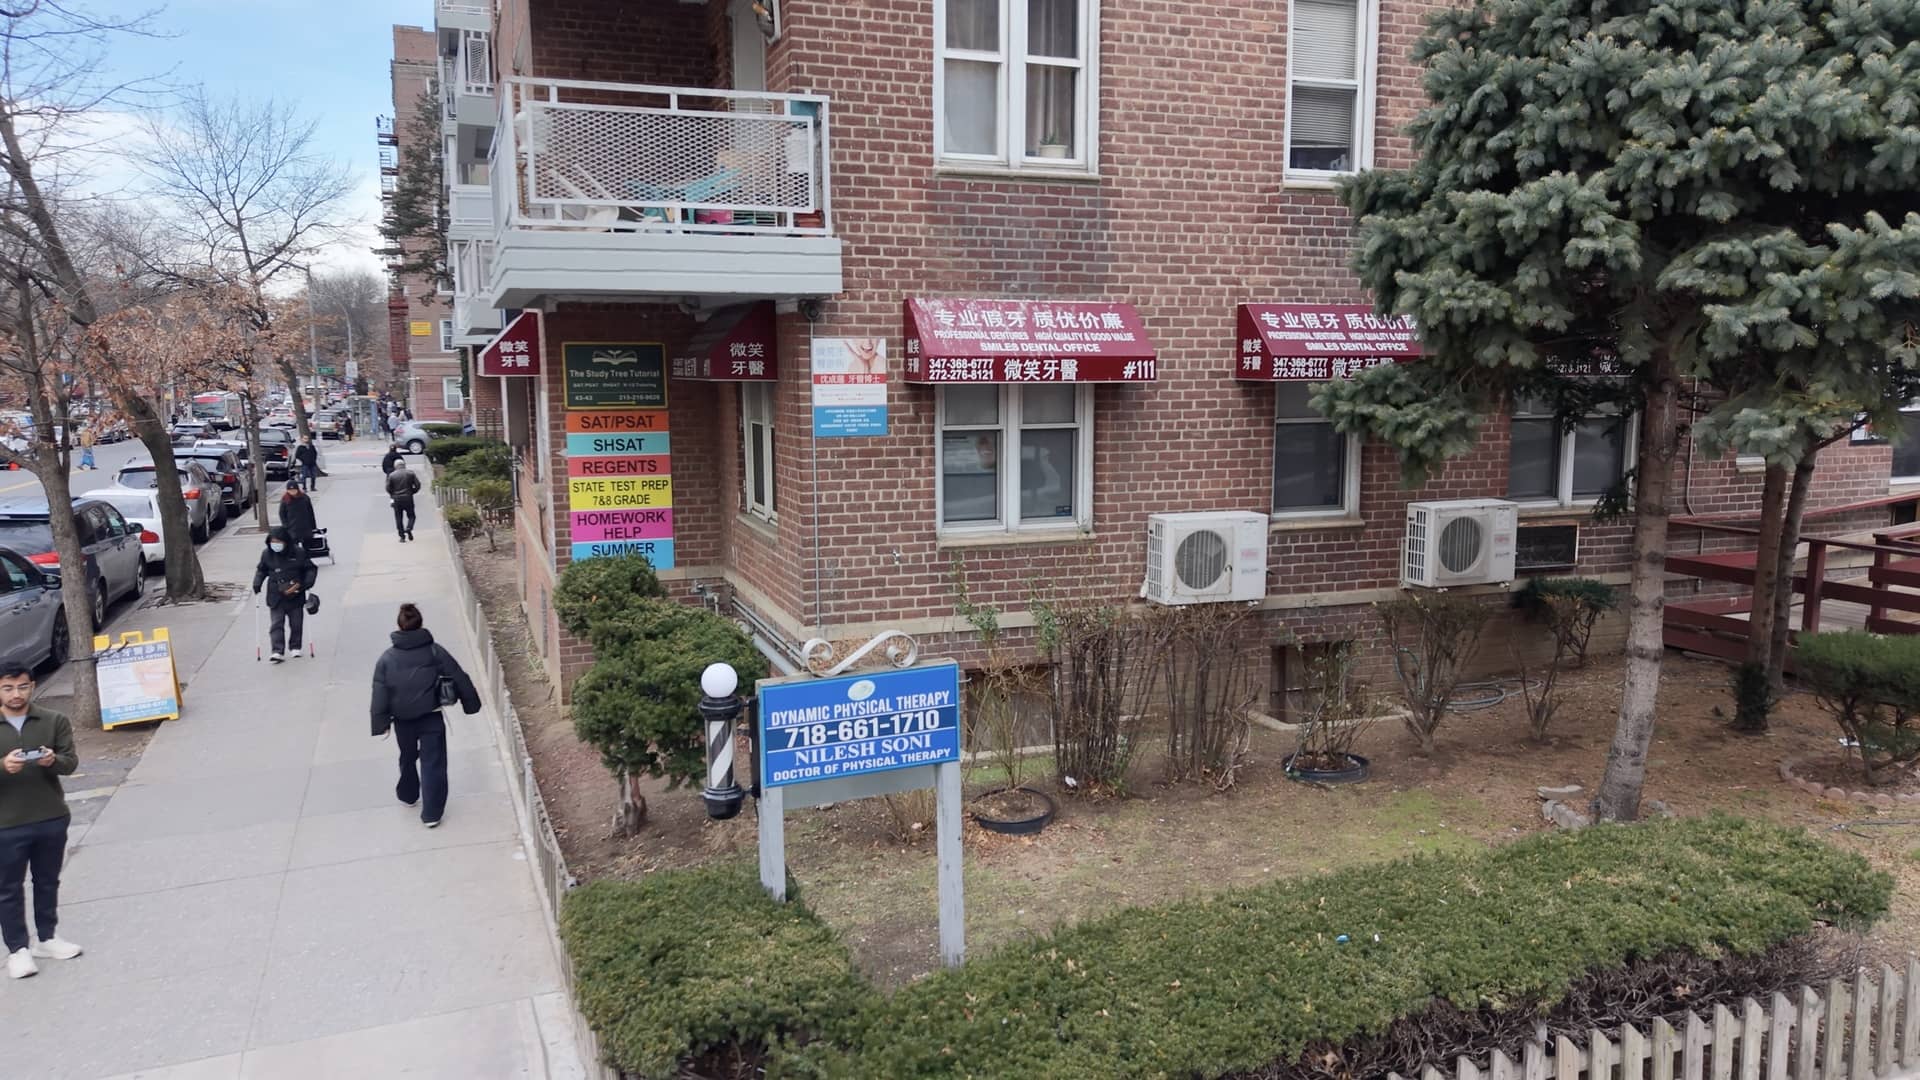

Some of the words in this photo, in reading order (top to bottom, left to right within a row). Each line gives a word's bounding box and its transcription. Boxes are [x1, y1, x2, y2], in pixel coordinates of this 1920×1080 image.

[934, 308, 1027, 328] 专业假牙
[1034, 310, 1125, 330] 质优价廉
[1260, 312, 1340, 329] 专业假牙
[934, 330, 990, 339] PROFESSIONAL
[730, 342, 764, 357] 微笑
[980, 342, 1019, 352] SMILES
[1020, 342, 1062, 352] DENTAL
[1062, 343, 1101, 352] OFFICE
[1305, 342, 1340, 351] SMILES
[1340, 342, 1376, 351] DENTAL
[1376, 342, 1408, 351] OFFICE
[731, 360, 765, 376] 牙醫
[928, 358, 994, 369] 347-368-6777
[1004, 358, 1078, 381] 微笑牙醫
[1122, 360, 1155, 380] #111
[569, 370, 584, 378] The
[586, 370, 609, 380] Study
[610, 370, 629, 378] Tree
[630, 370, 660, 378] Tutorial
[928, 369, 994, 380] 272-276-8121
[580, 416, 655, 429] SAT/PSAT
[594, 438, 645, 452] SHSAT
[582, 460, 657, 474] REGENTS
[572, 481, 604, 493] STATE
[611, 480, 636, 492] TEST
[642, 480, 669, 490] PREP
[592, 496, 612, 506] 7&8
[614, 494, 650, 505] GRADE
[577, 512, 666, 526] HOMEWORK
[604, 527, 642, 540] HELP
[592, 542, 655, 557] SUMMER
[771, 706, 830, 726] DYNAMIC
[834, 698, 893, 718] PHYSICAL
[896, 690, 950, 710] THERAPY
[784, 710, 940, 749] 718-661-1710
[794, 741, 876, 766] NILESH
[881, 734, 932, 754] SONI
[774, 765, 821, 782] DOCTOR
[824, 764, 839, 775] OF
[842, 755, 898, 772] PHYSICAL
[902, 748, 951, 764] THERAPY
